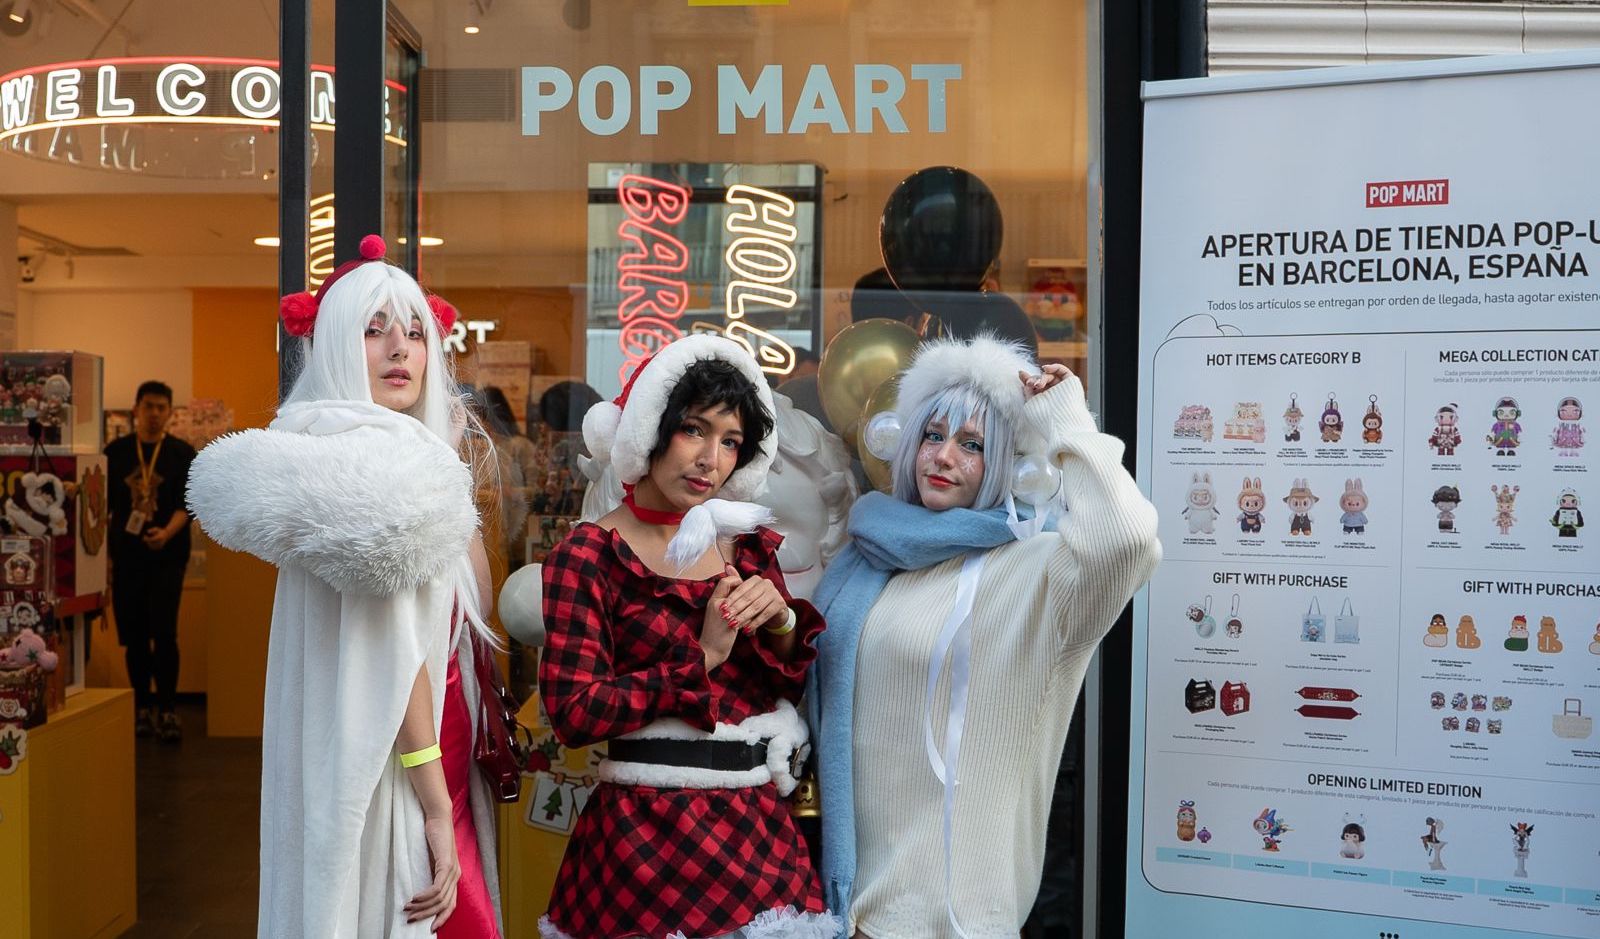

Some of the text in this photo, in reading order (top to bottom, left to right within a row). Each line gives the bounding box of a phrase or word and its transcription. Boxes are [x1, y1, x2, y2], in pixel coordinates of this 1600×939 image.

[521, 64, 962, 136] POP MART
[1369, 183, 1445, 204] POP MART
[1201, 229, 1348, 258] APERTURA
[1355, 228, 1391, 252] DE
[1399, 223, 1506, 250] TIENDA
[1239, 246, 1589, 286] EN BARCELONA, ESPAÑA
[1207, 300, 1237, 310] Todos
[1238, 300, 1253, 310] los
[1256, 299, 1301, 309] artículos
[1318, 298, 1365, 309] entregan
[1368, 297, 1386, 309] por
[1388, 296, 1420, 306] orden
[1422, 295, 1436, 305] de
[1438, 294, 1482, 307] llegada,
[1484, 293, 1515, 303] hasta
[1517, 292, 1556, 306] agotar
[1207, 352, 1361, 366] HOT ITEMS CATEGORY B
[1439, 351, 1478, 363] MEGA
[1481, 349, 1568, 362] COLLECTION
[1213, 572, 1348, 588] GIFT WITH PURCHASE
[1463, 580, 1494, 593] GIFT
[1496, 582, 1532, 595] WITH
[1308, 773, 1482, 798] OPENING LIMITED EDITION
